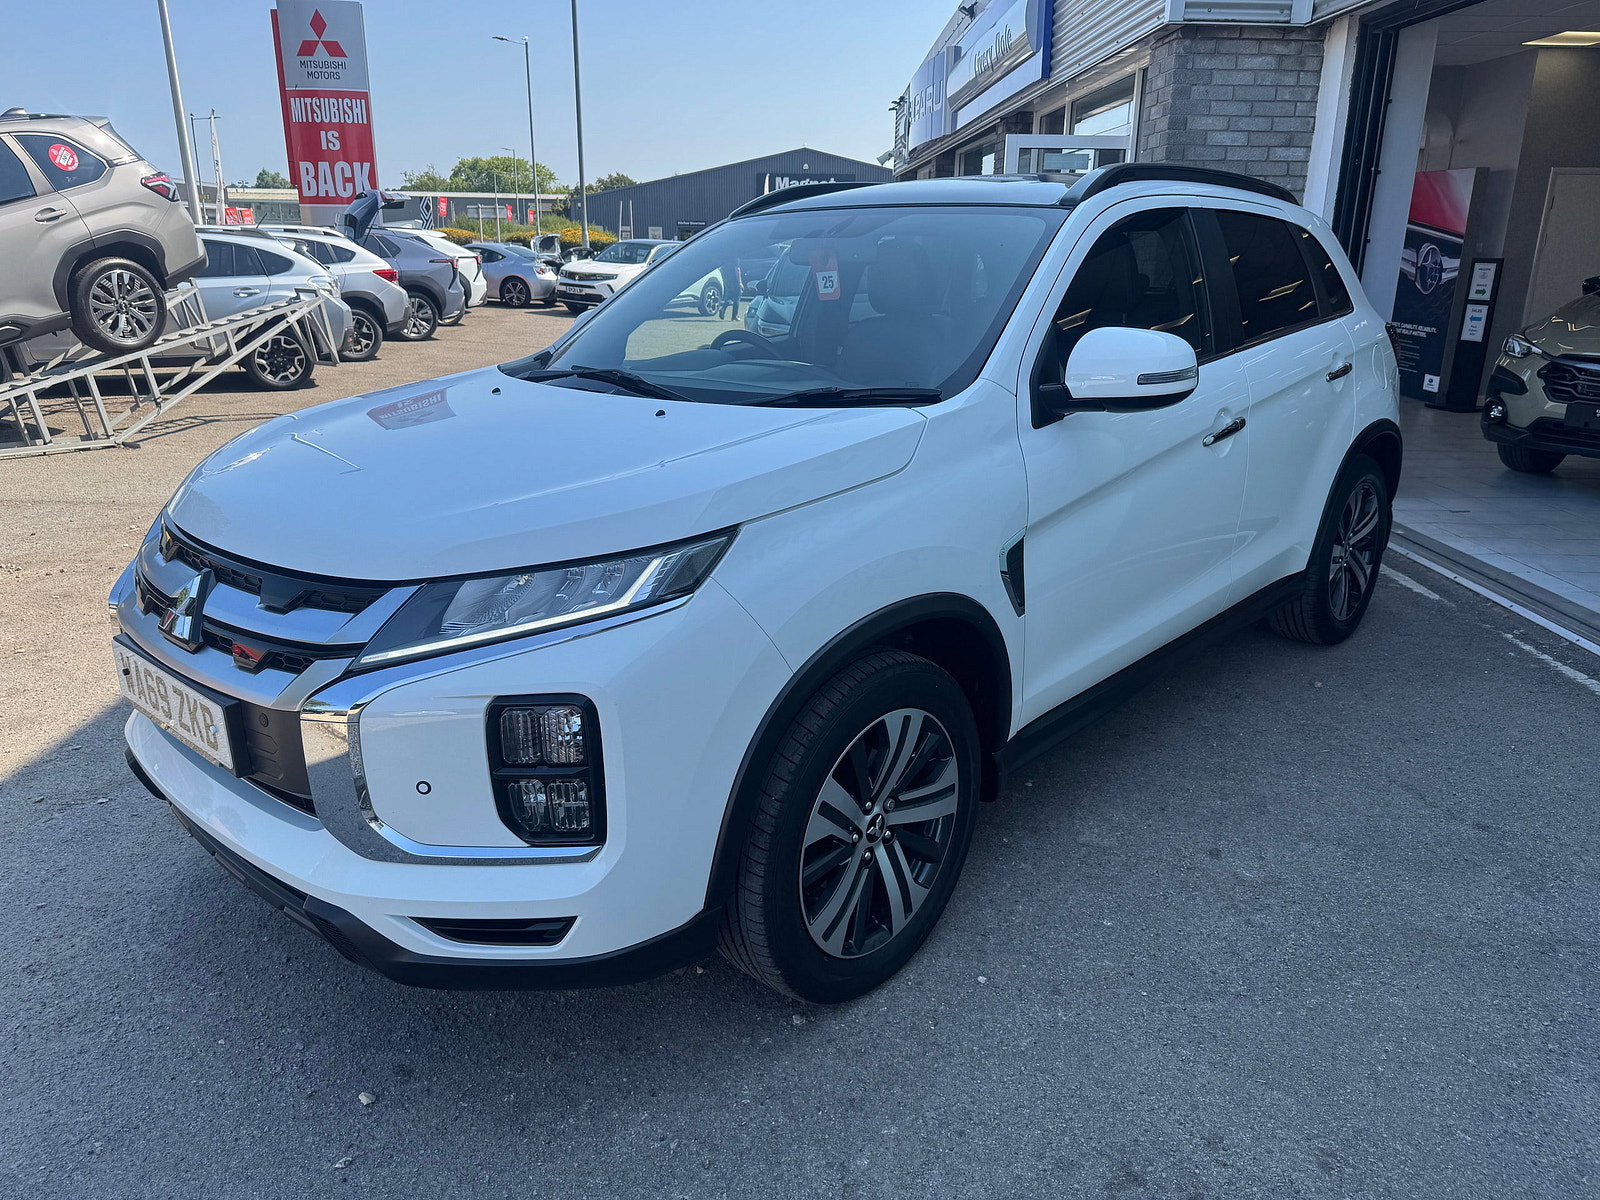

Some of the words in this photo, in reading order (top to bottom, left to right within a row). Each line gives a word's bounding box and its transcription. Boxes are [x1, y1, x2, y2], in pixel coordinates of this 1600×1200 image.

[299, 60, 347, 70] MITSUBISHI
[307, 71, 341, 80] MOTORS
[290, 96, 368, 125] MITSUBISHI
[320, 130, 341, 150] IS
[299, 161, 372, 198] BACK
[822, 275, 834, 289] 25
[120, 652, 172, 721] WA69
[171, 684, 219, 751] ZKB
